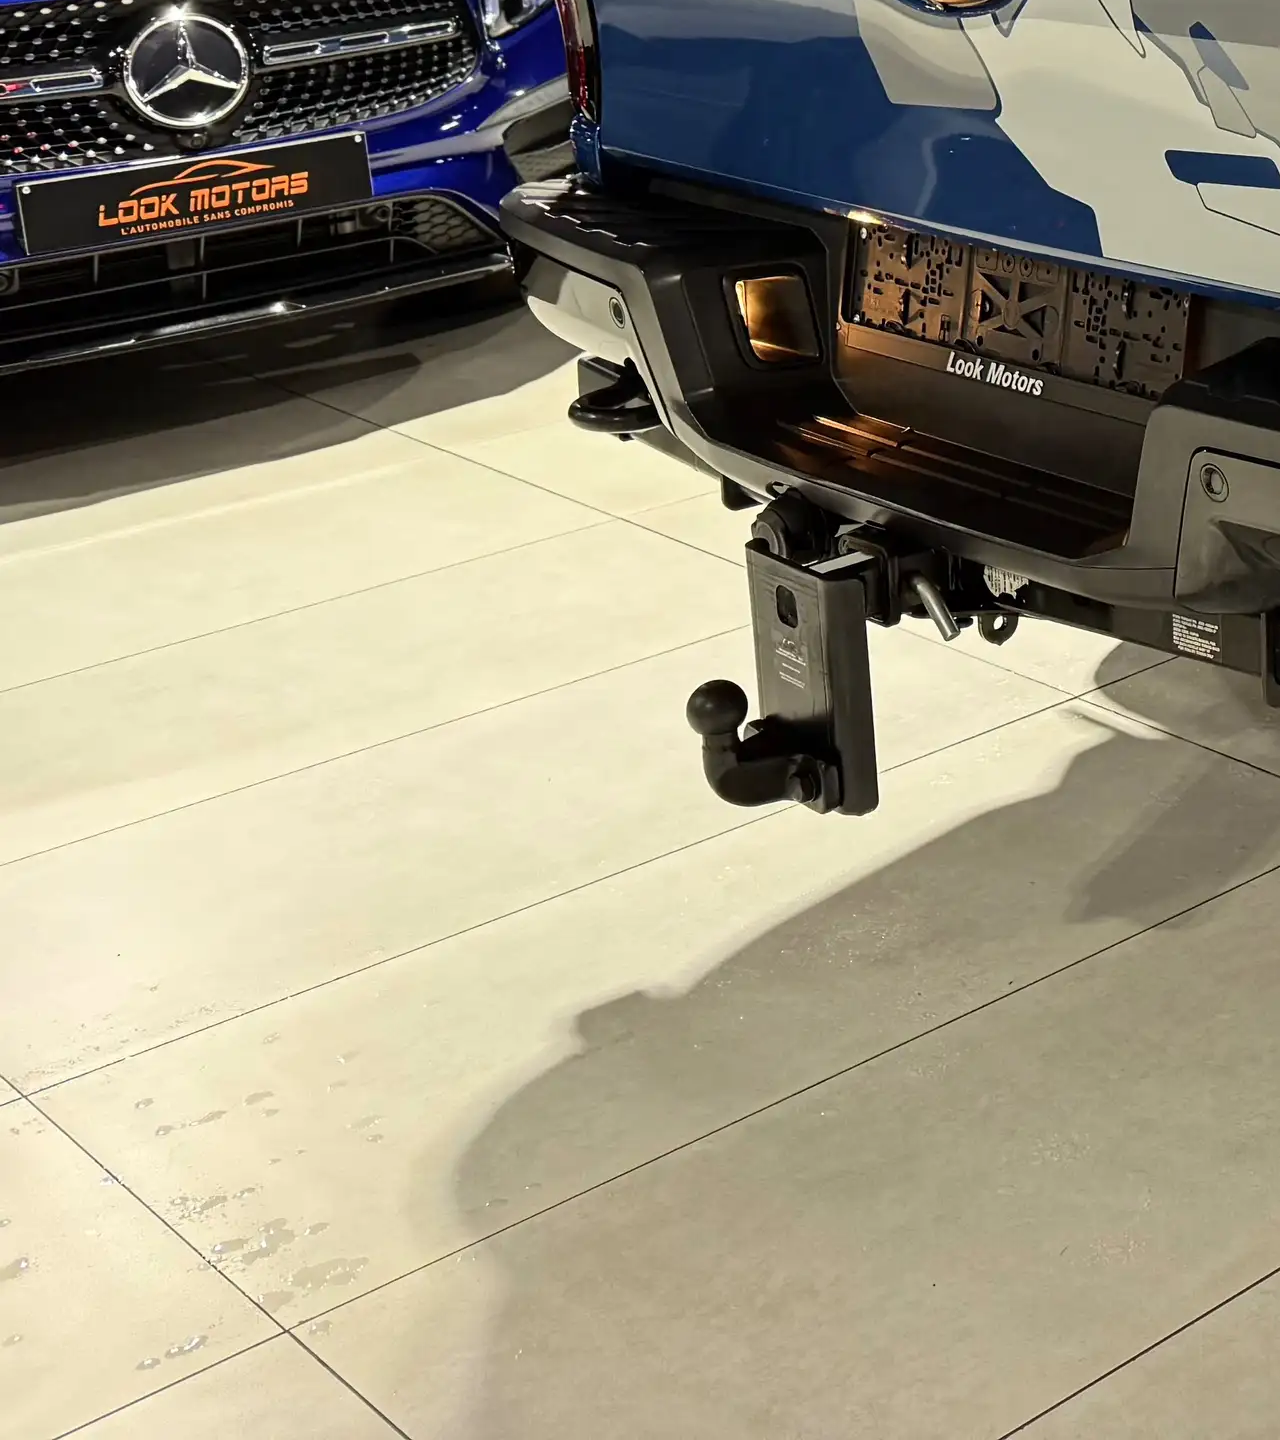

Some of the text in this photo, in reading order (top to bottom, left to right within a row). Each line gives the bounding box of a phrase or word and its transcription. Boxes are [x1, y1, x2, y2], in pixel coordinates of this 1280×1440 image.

[98, 171, 309, 226] LOOK MOTORS
[121, 200, 294, 236] L'AUTOMOBILE SANS COMPROMIS
[946, 351, 1043, 396] Look Motors
